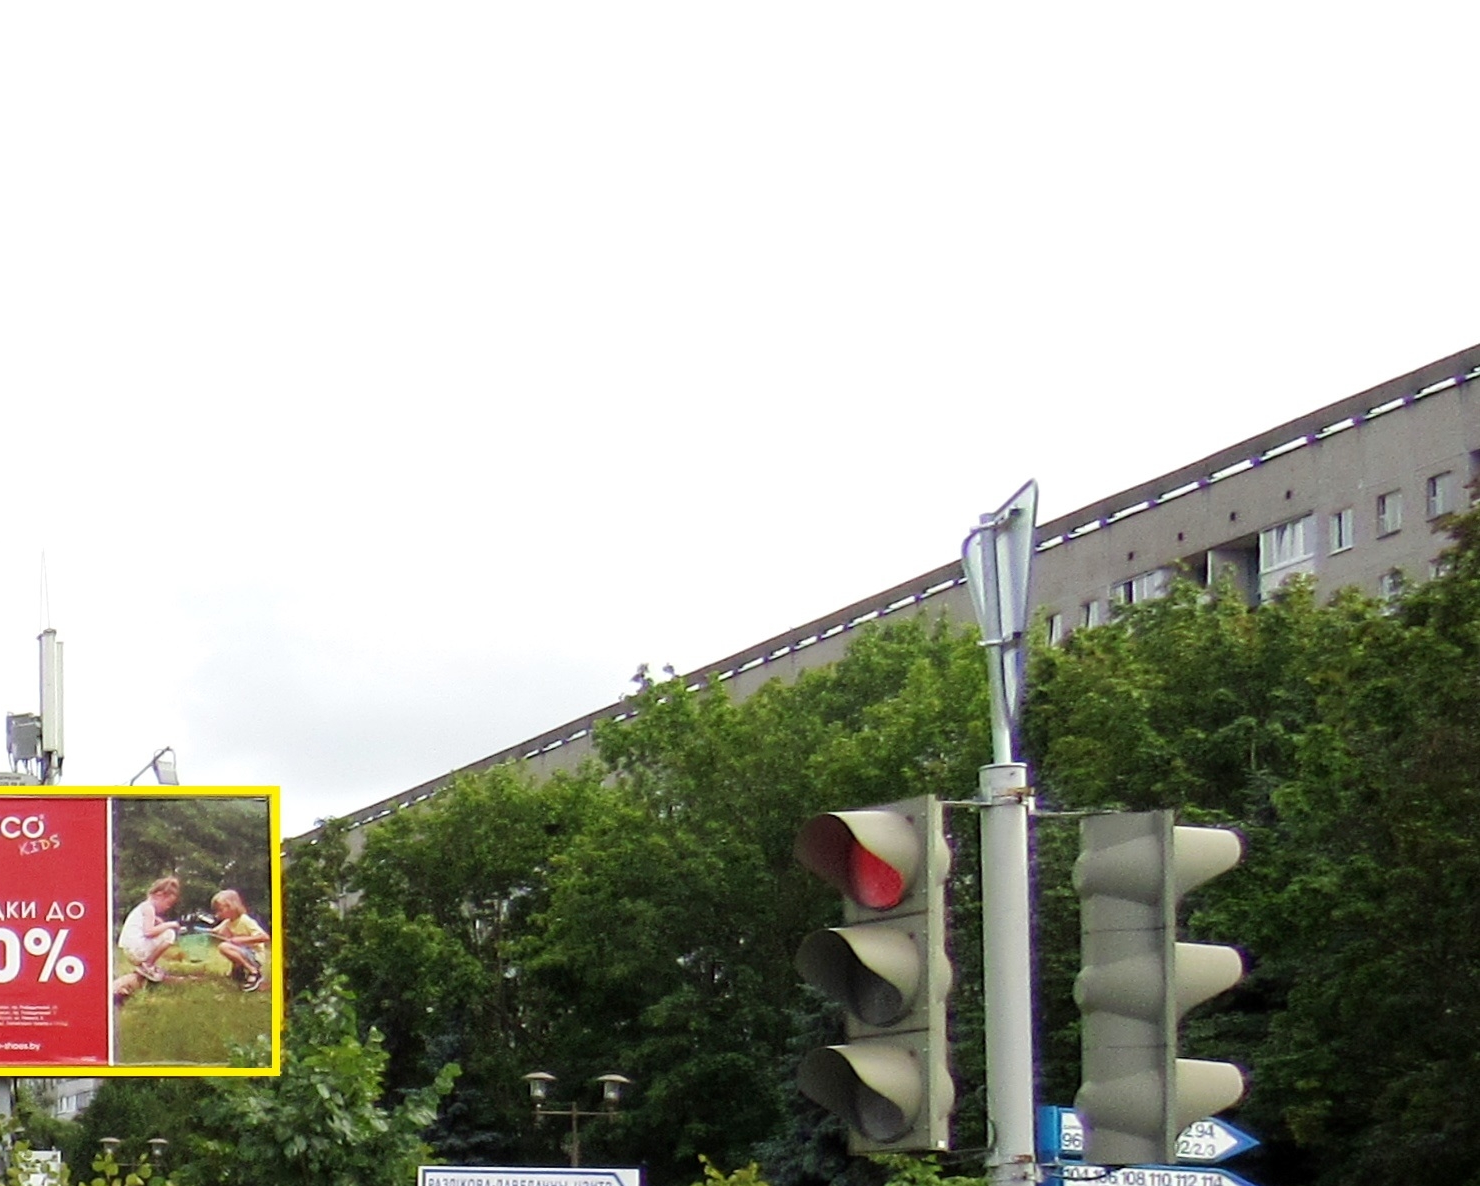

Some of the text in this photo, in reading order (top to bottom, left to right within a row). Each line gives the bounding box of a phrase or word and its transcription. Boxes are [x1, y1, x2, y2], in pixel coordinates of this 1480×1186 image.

[18, 833, 61, 856] KIDS
[45, 901, 85, 922] ДО
[1063, 1132, 1082, 1148] 96
[1122, 1171, 1146, 1186] 108
